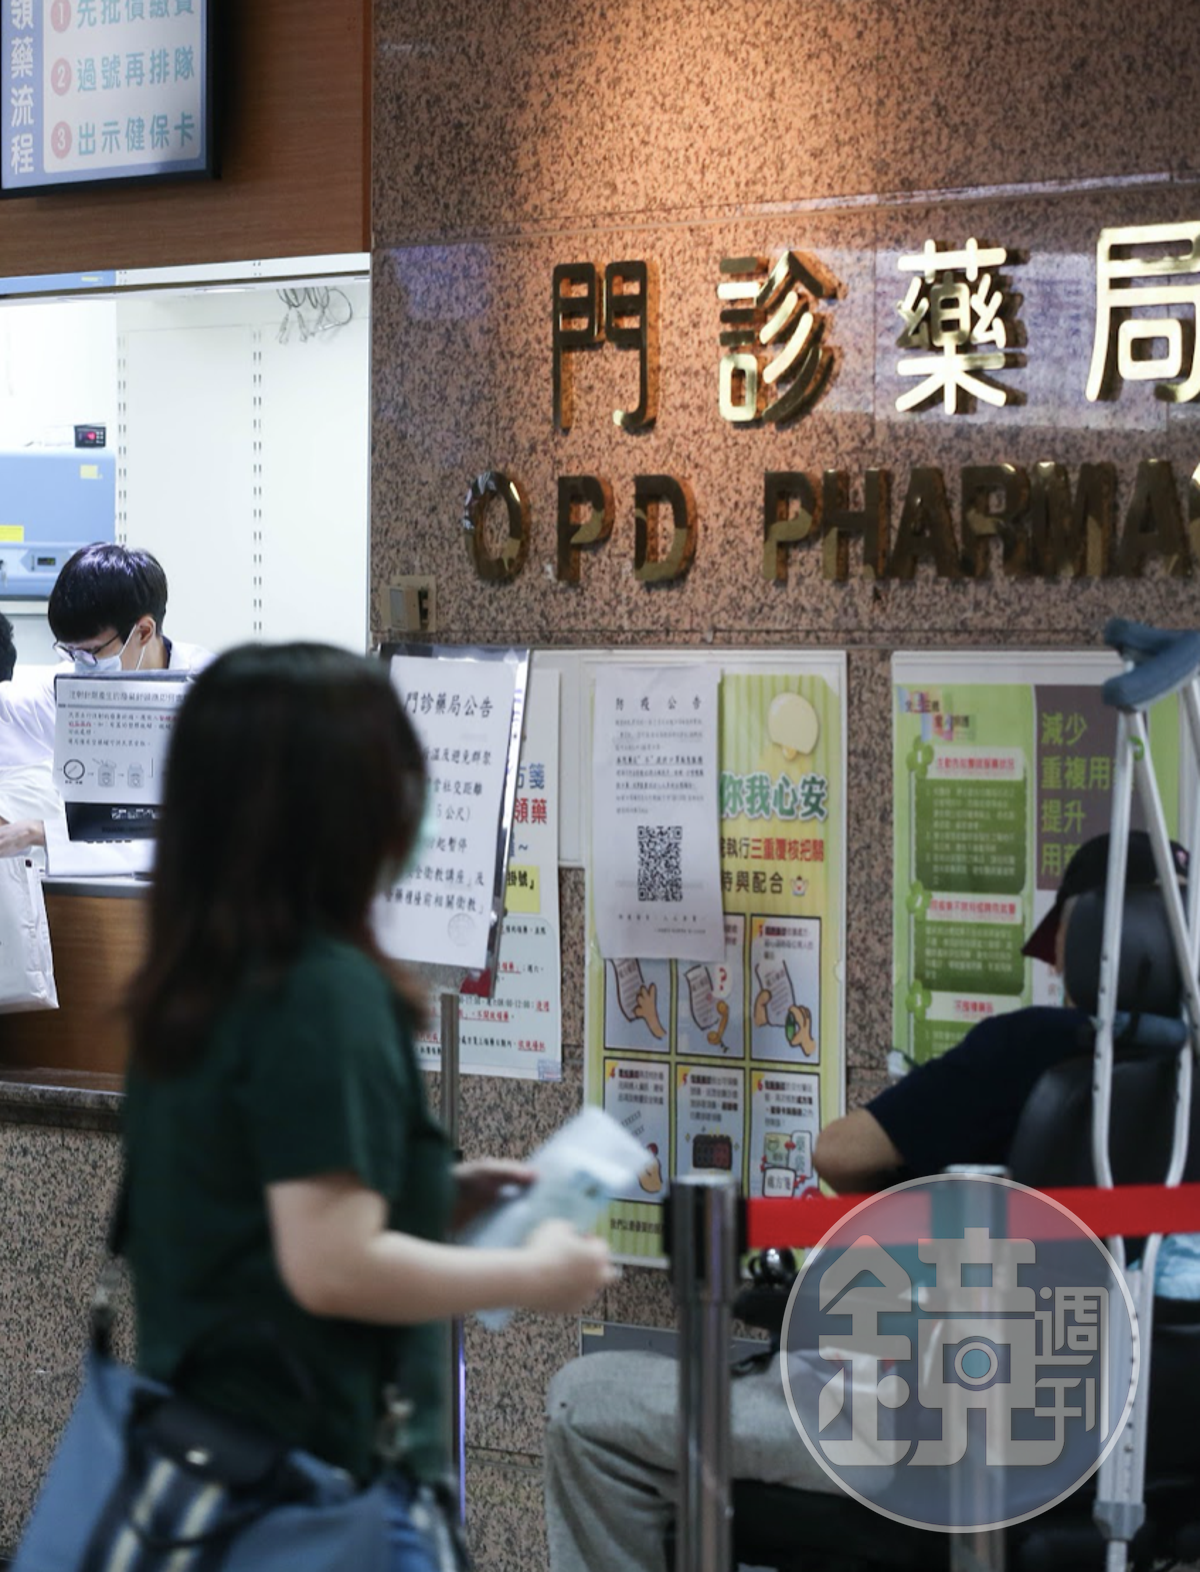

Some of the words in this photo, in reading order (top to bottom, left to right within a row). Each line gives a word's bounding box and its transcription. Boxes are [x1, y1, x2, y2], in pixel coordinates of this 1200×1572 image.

[10, 0, 35, 175] 領藥流程
[76, 45, 195, 93] 過號再排隊
[77, 112, 195, 157] 出示健保卡
[552, 221, 1200, 432] 門診藥局
[464, 470, 697, 583] OPD
[762, 458, 1200, 582] PHARMA
[405, 691, 494, 719] 門診藥局公告
[1041, 711, 1088, 746] 減少
[425, 746, 492, 767] 溫及避免群聚
[1041, 755, 1134, 791] 重複用
[1041, 797, 1087, 834] 提升
